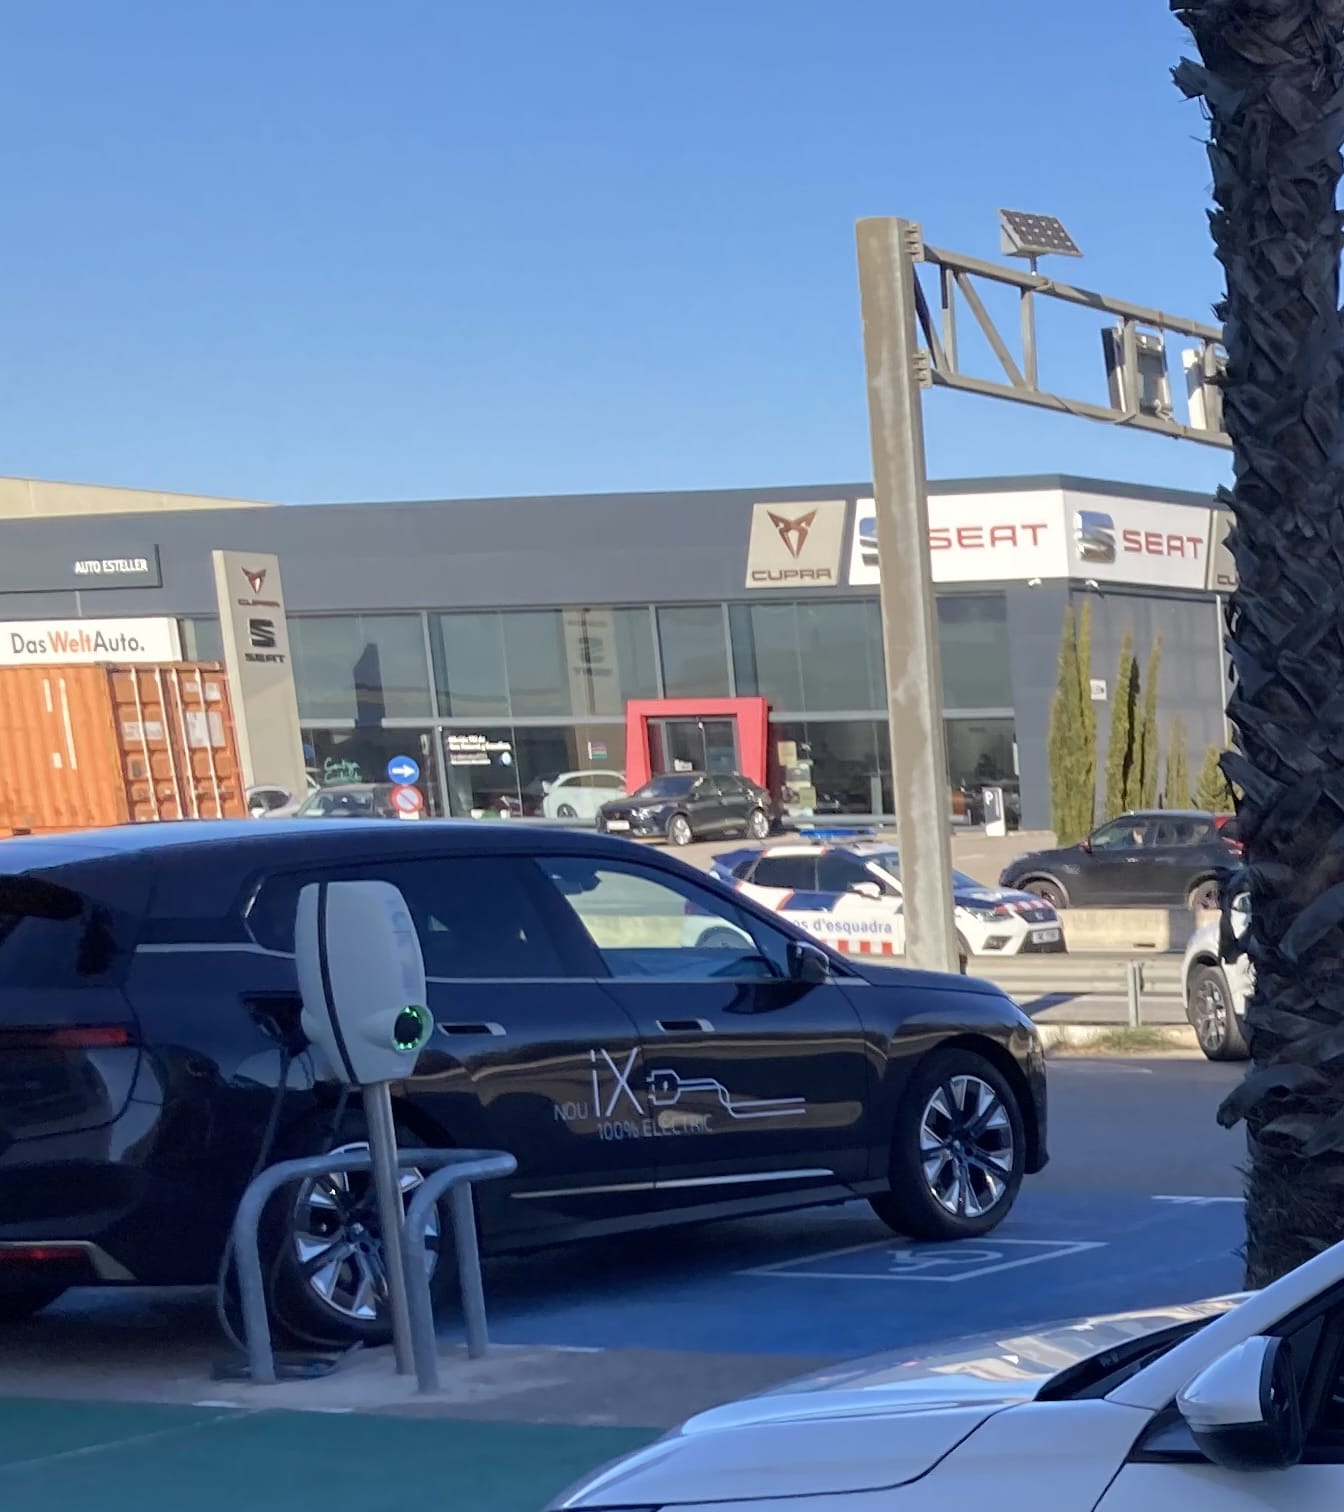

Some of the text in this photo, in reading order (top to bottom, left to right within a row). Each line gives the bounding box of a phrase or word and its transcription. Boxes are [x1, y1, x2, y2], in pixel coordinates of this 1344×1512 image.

[927, 523, 1049, 551] SEAT
[1122, 529, 1204, 560] SEAT
[75, 560, 101, 575] AUTO
[752, 567, 832, 582] CUPRA
[11, 632, 47, 654] Das
[813, 918, 893, 935] d'esquadra
[554, 1101, 588, 1121] NOU
[597, 1120, 640, 1141] 100%
